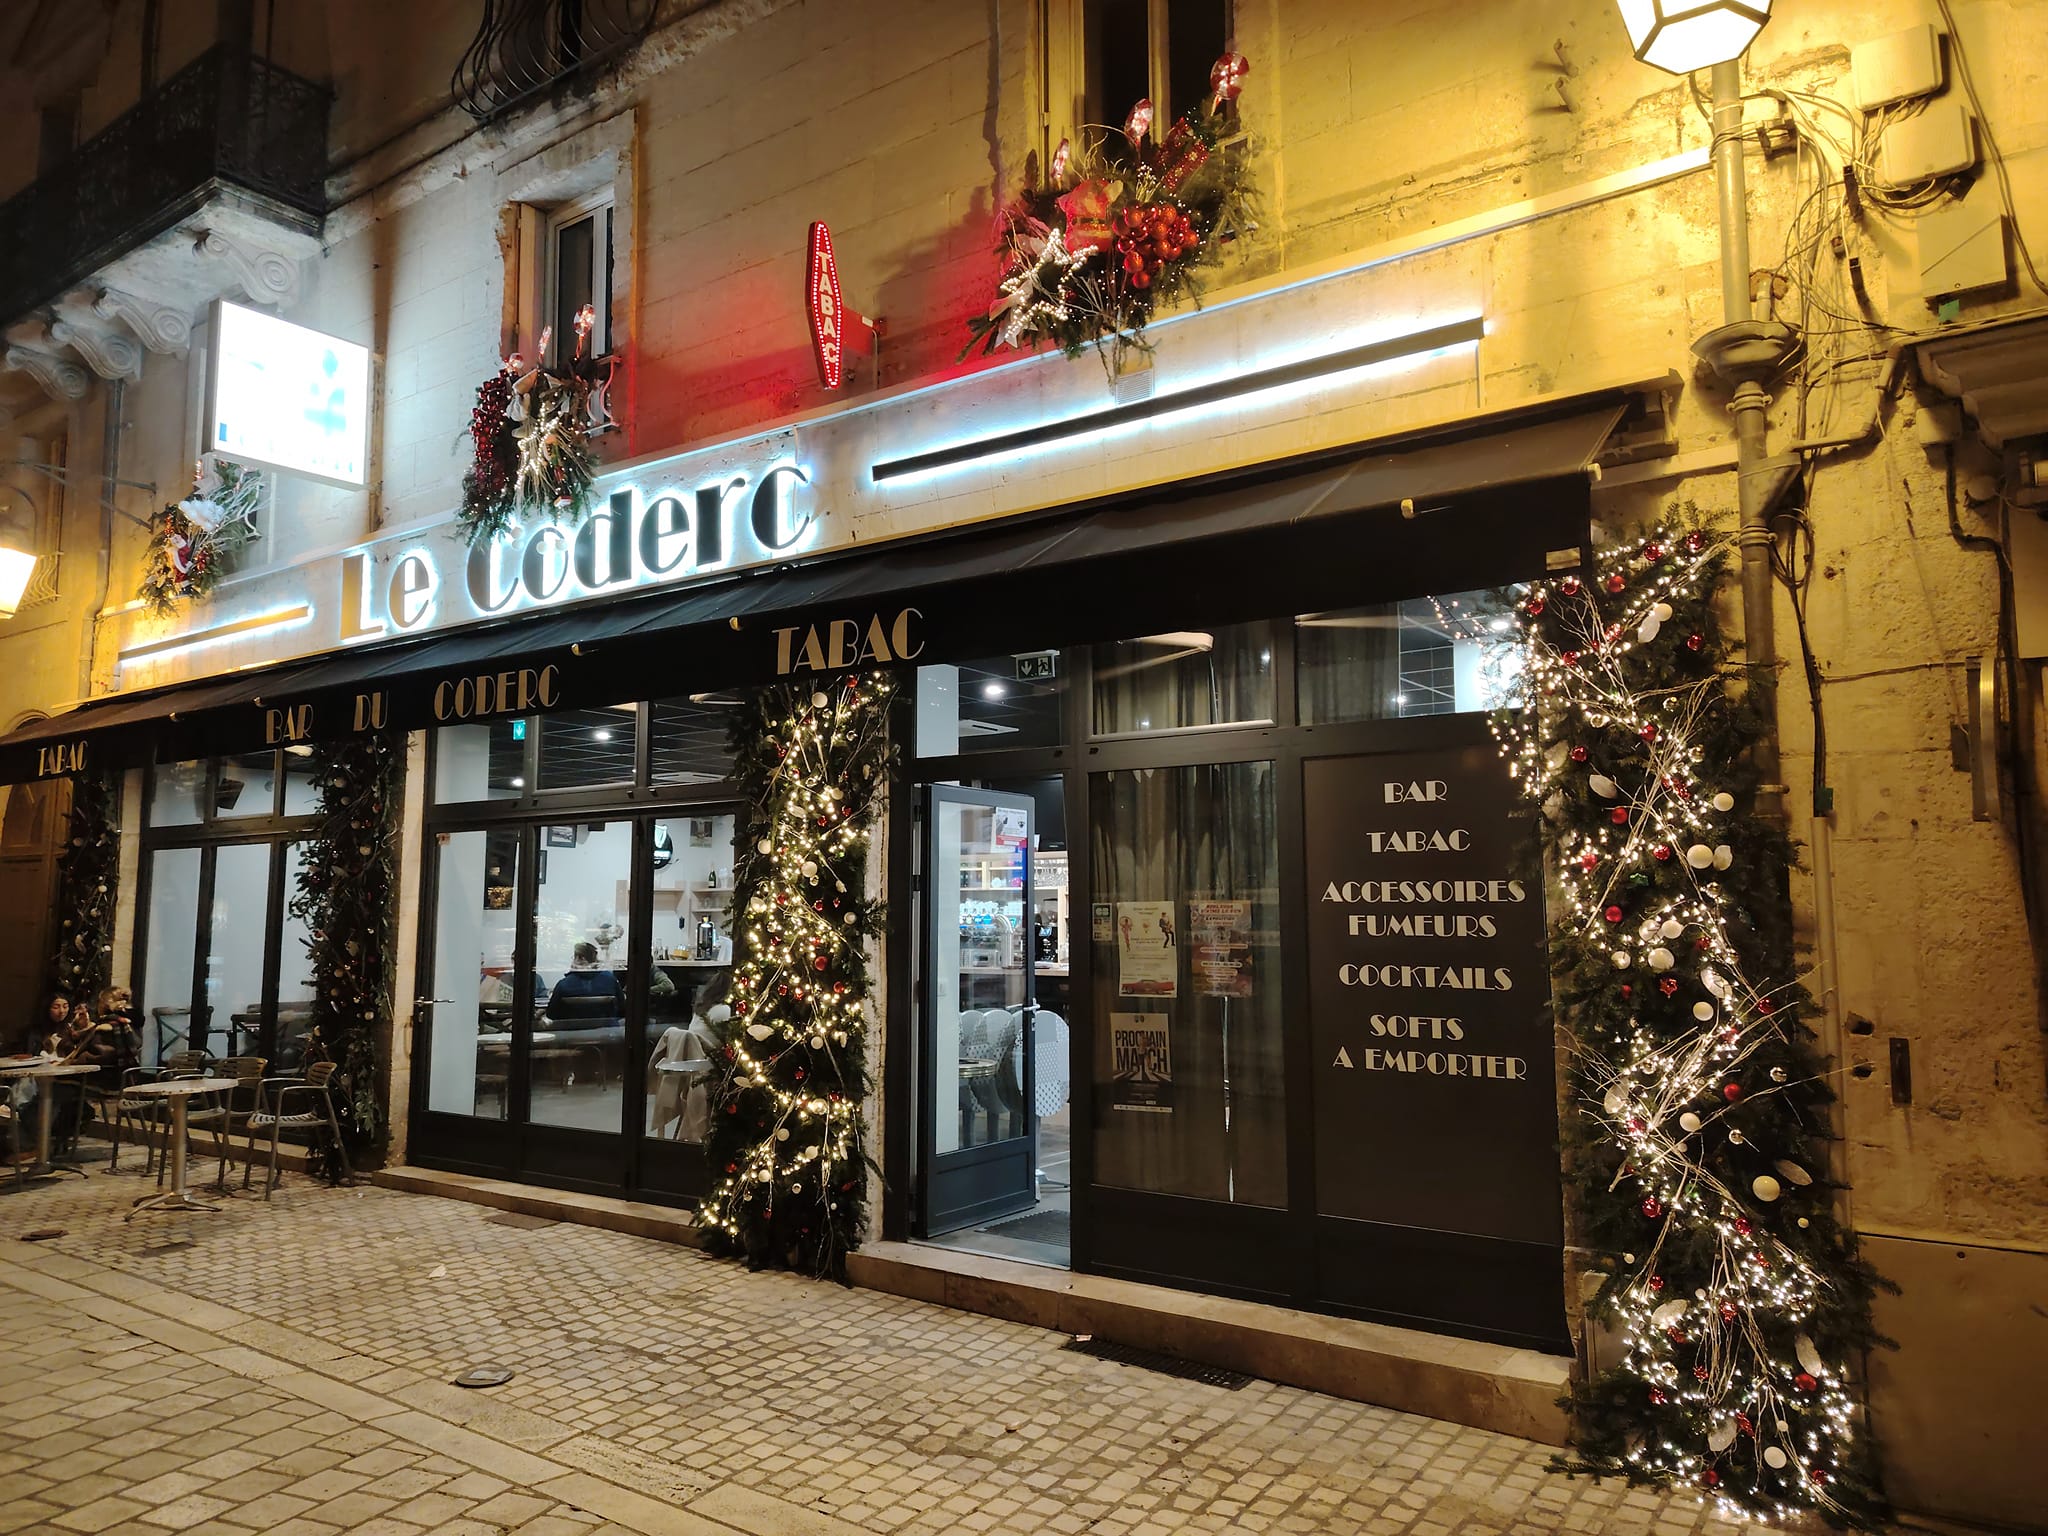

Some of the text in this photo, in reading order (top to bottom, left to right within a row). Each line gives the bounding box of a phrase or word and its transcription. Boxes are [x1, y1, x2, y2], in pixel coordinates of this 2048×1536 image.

[817, 251, 837, 363] TABAC
[340, 465, 812, 641] Le Coderc
[770, 607, 925, 675] TABAC
[265, 664, 560, 744] BAR DU CODERC
[37, 740, 89, 777] TABAC
[1383, 780, 1448, 804] BAR
[1366, 828, 1471, 853] TABAC
[1321, 879, 1526, 903] ACCESSOIRES
[1348, 914, 1497, 938] FUMEURS
[1338, 963, 1513, 991] COCKTAILS
[1115, 1030, 1166, 1048] PROCAIN
[1369, 1014, 1465, 1041] SOFTS
[1116, 1047, 1168, 1073] MACH
[1332, 1046, 1527, 1081] A EMPORTER
